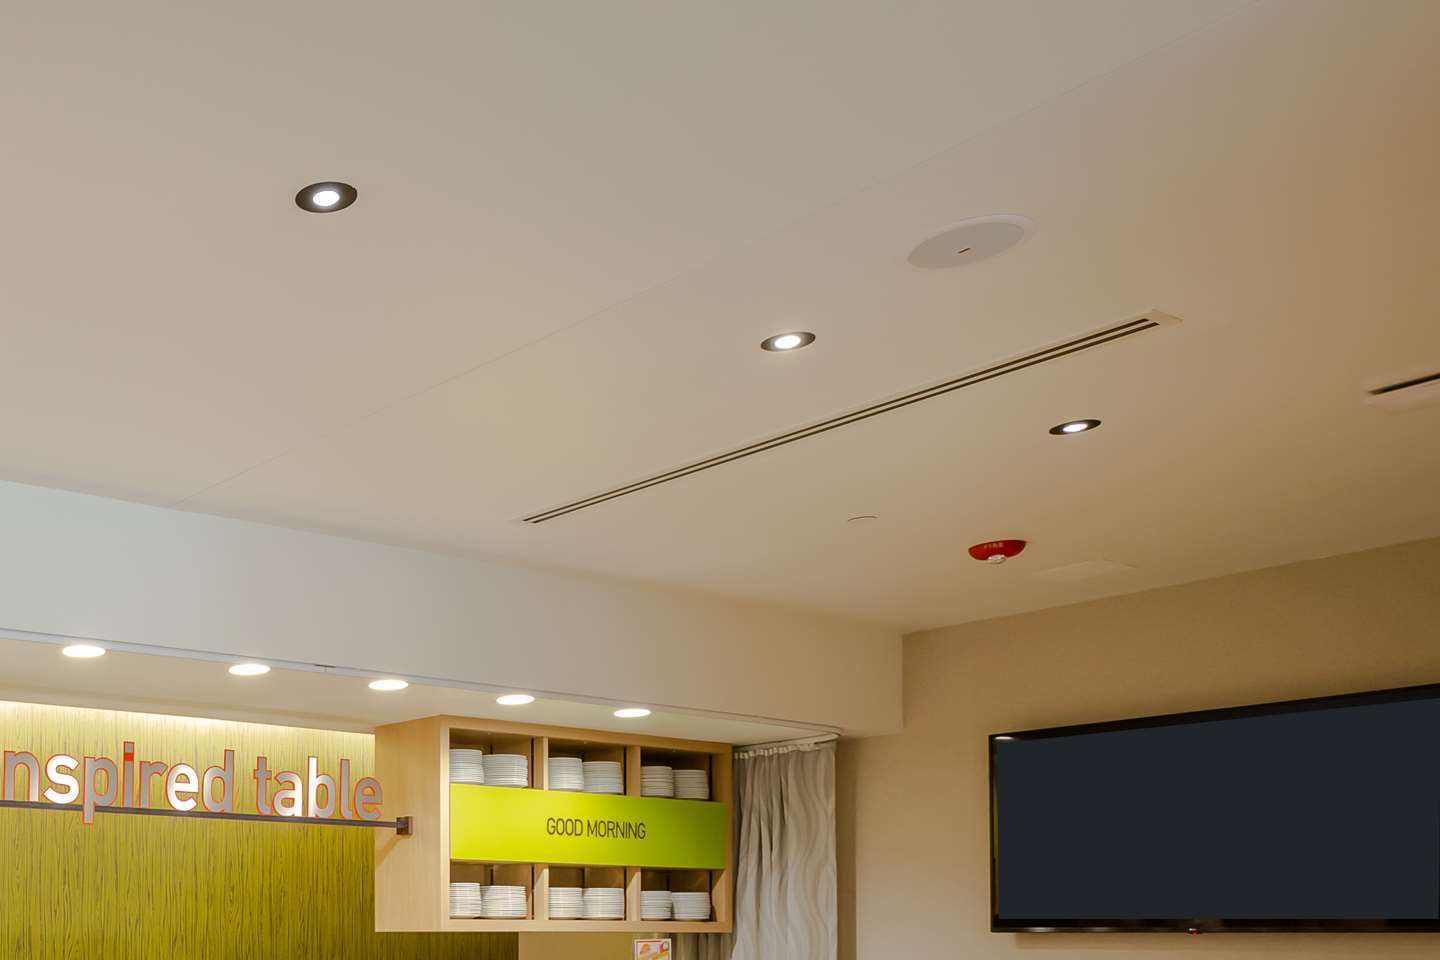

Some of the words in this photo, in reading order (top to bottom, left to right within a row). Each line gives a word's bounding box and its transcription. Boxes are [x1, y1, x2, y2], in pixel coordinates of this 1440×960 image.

[253, 755, 383, 820] table
[546, 817, 584, 837] GOOD
[586, 820, 647, 840] MORNING
